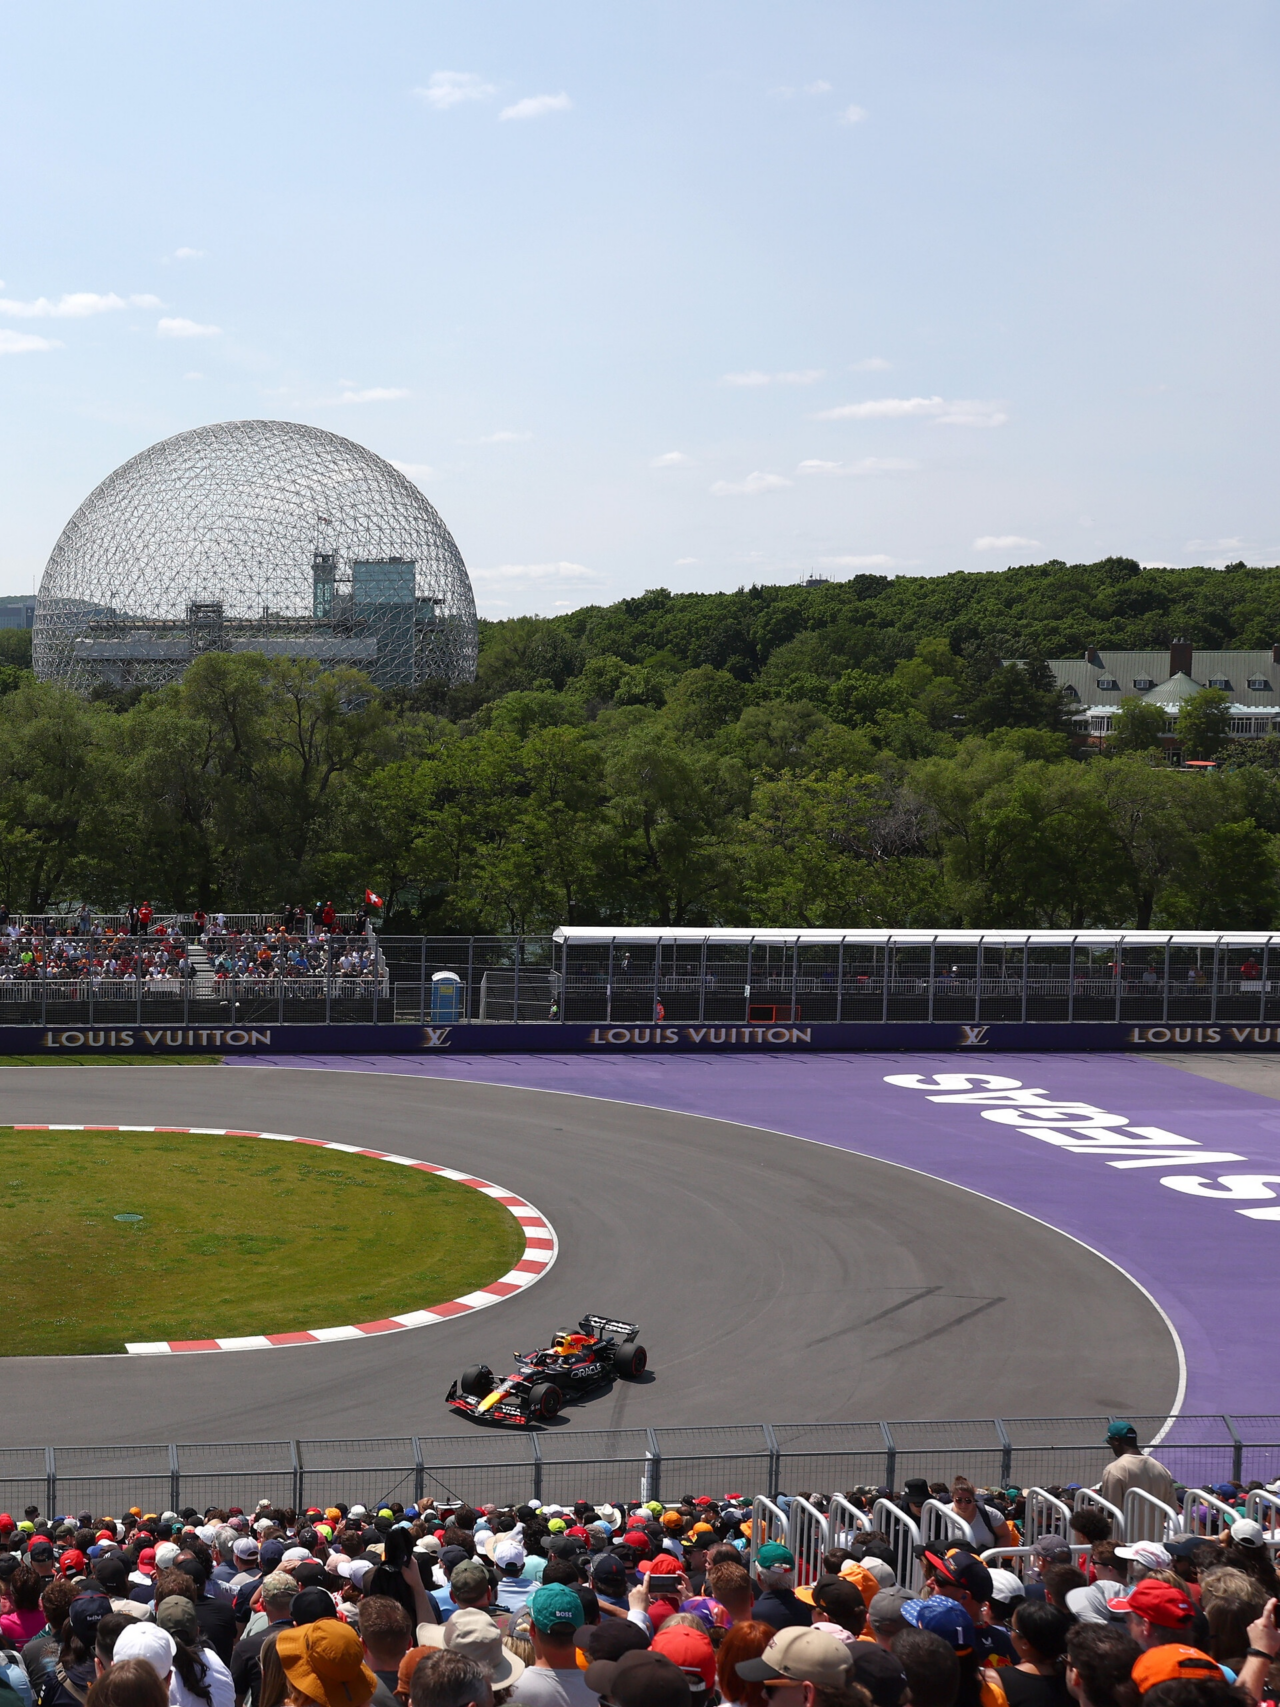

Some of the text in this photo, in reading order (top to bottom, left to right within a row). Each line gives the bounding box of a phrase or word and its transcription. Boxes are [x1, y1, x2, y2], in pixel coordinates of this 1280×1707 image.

[47, 1030, 271, 1047] LOUIS VUITTON
[593, 1027, 812, 1044] LOUIS VUITTON
[1133, 1027, 1221, 1044] LOUIS
[883, 1073, 1249, 1169] VEGAS
[570, 1362, 602, 1379] ORACLE
[555, 1610, 572, 1618] BOSS
